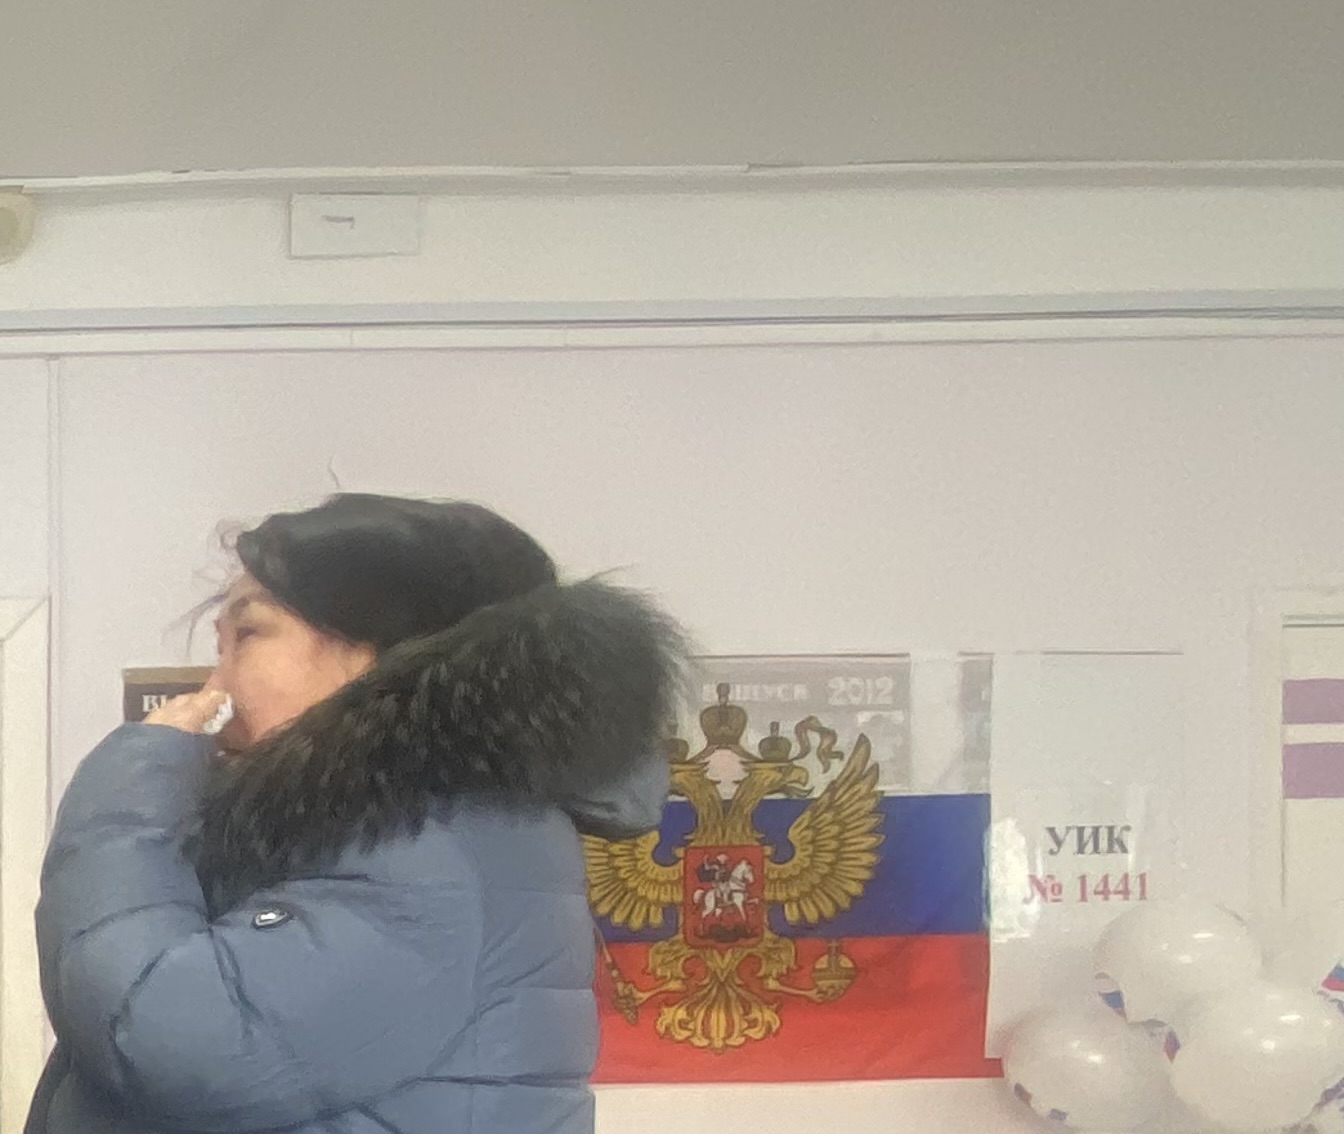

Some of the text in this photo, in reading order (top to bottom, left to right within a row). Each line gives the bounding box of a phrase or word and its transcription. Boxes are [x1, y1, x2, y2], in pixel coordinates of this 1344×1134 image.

[703, 676, 895, 705] ВПУСК 2012
[1045, 825, 1131, 857] УИК
[1027, 873, 1149, 901] № 1441
